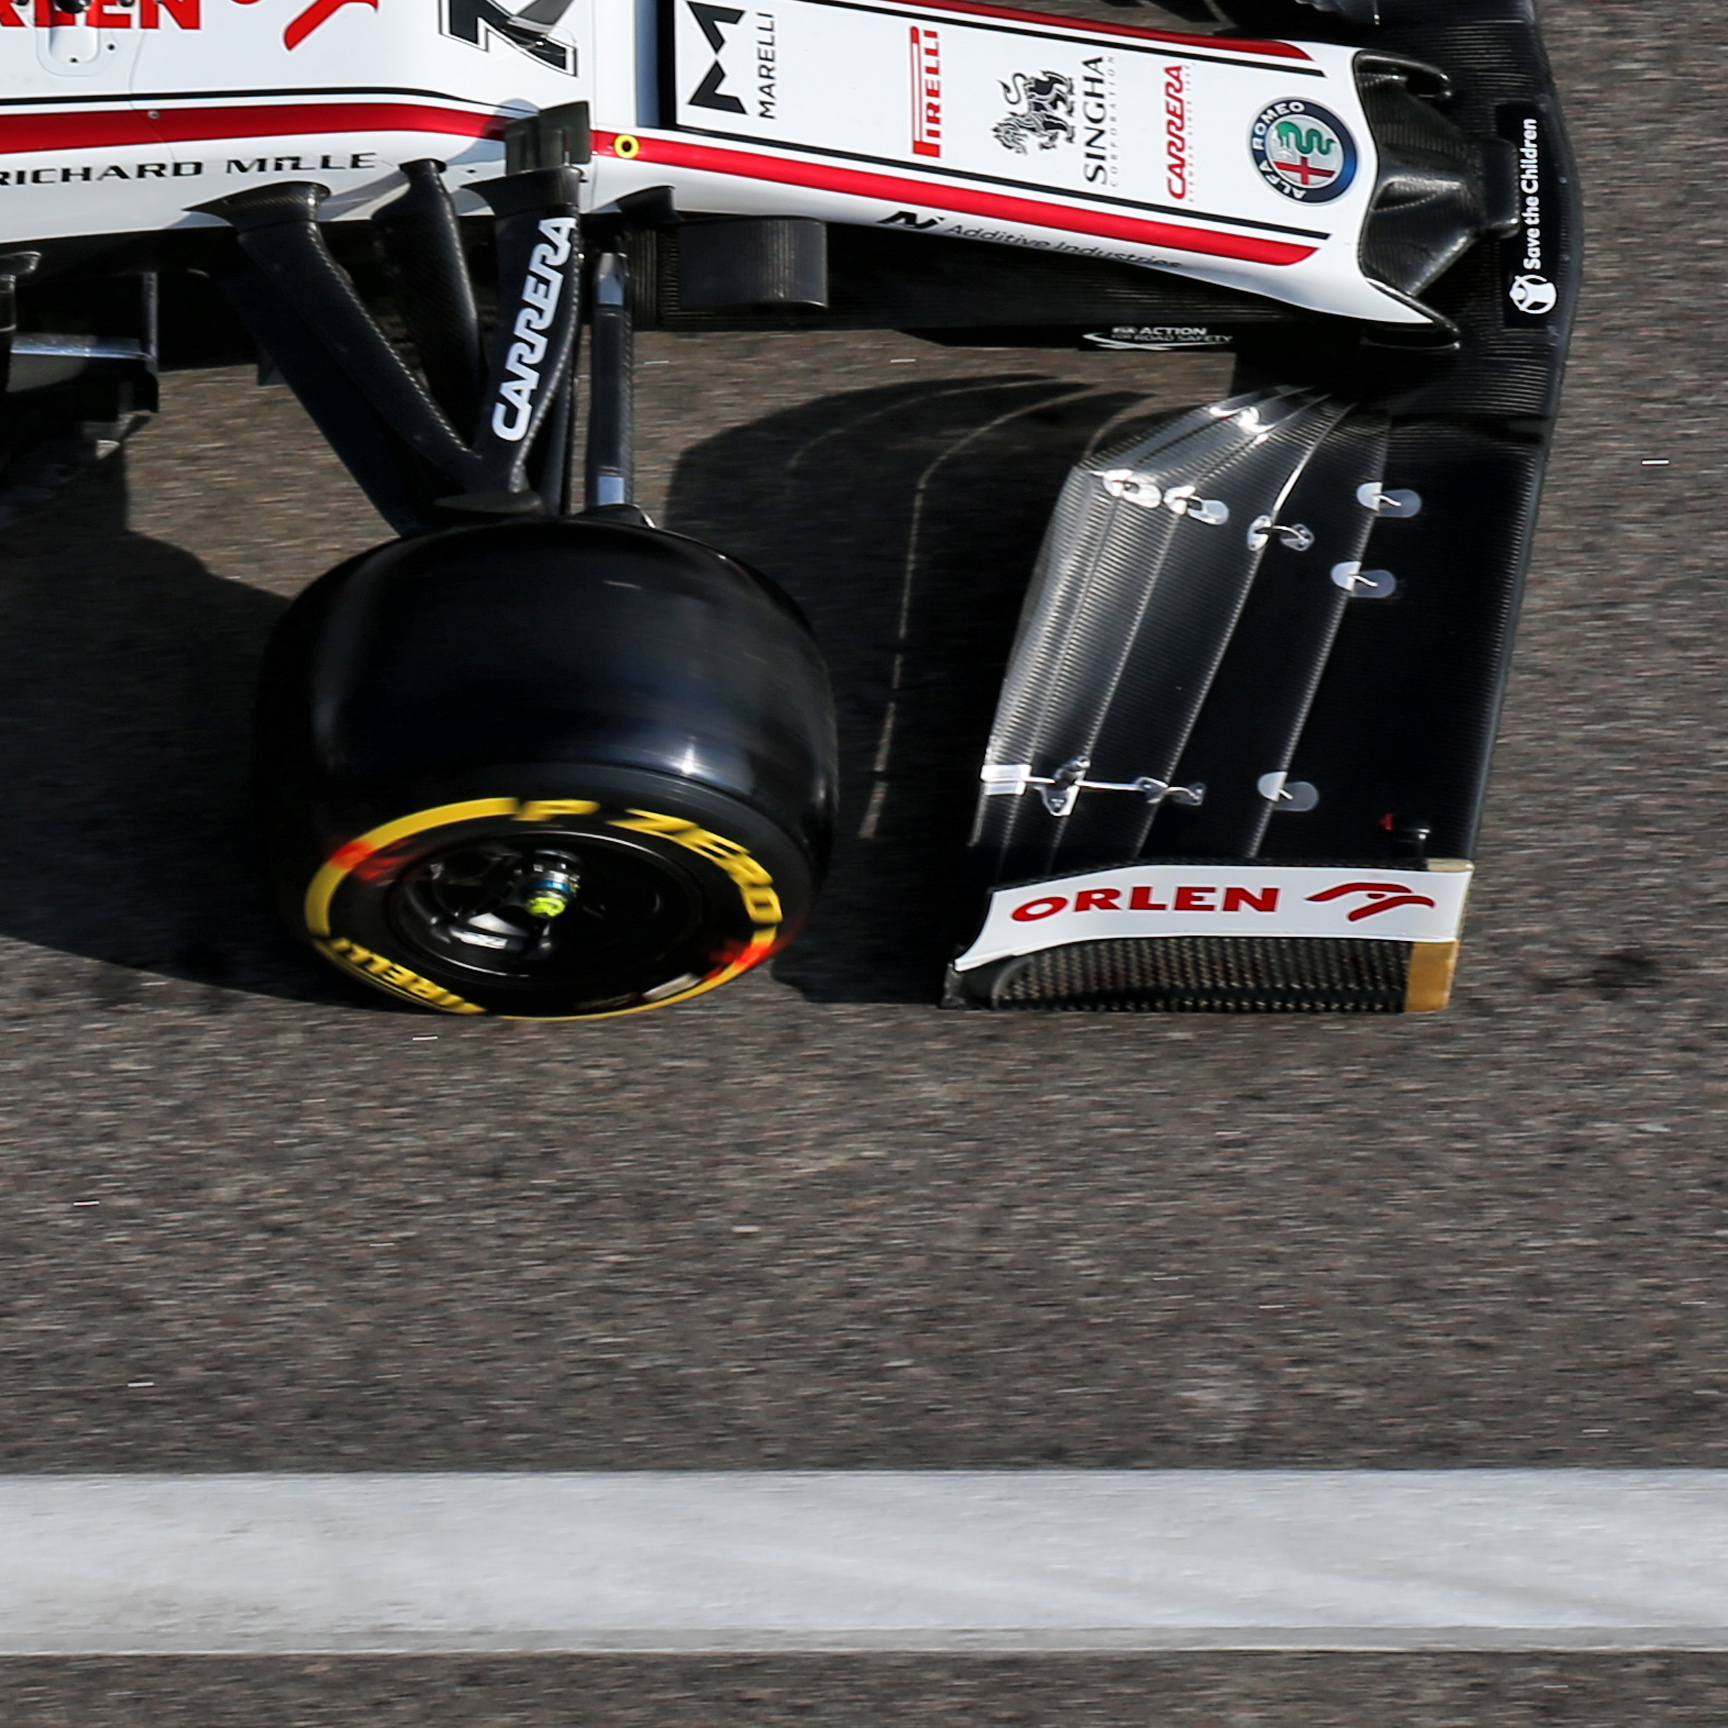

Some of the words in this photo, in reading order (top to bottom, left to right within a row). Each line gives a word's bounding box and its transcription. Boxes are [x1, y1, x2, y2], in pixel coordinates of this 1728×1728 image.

[757, 12, 777, 120] MARELLI
[909, 25, 942, 158] PIRELLI
[1082, 56, 1108, 186] SINGHA
[1106, 55, 1119, 188] CORPORATION
[1163, 65, 1187, 200] CARRERA
[1251, 100, 1306, 151] ROMEO
[226, 152, 379, 176] MILLE
[1258, 159, 1307, 200] ALFA
[1519, 118, 1540, 194] Children
[1521, 196, 1541, 225] the
[944, 223, 1052, 249] Additive
[1054, 240, 1182, 268] Industries
[1523, 228, 1542, 270] Save
[492, 216, 577, 442] CARRERA
[1140, 326, 1208, 336] ACTION
[1009, 885, 1281, 924] ORLEN
